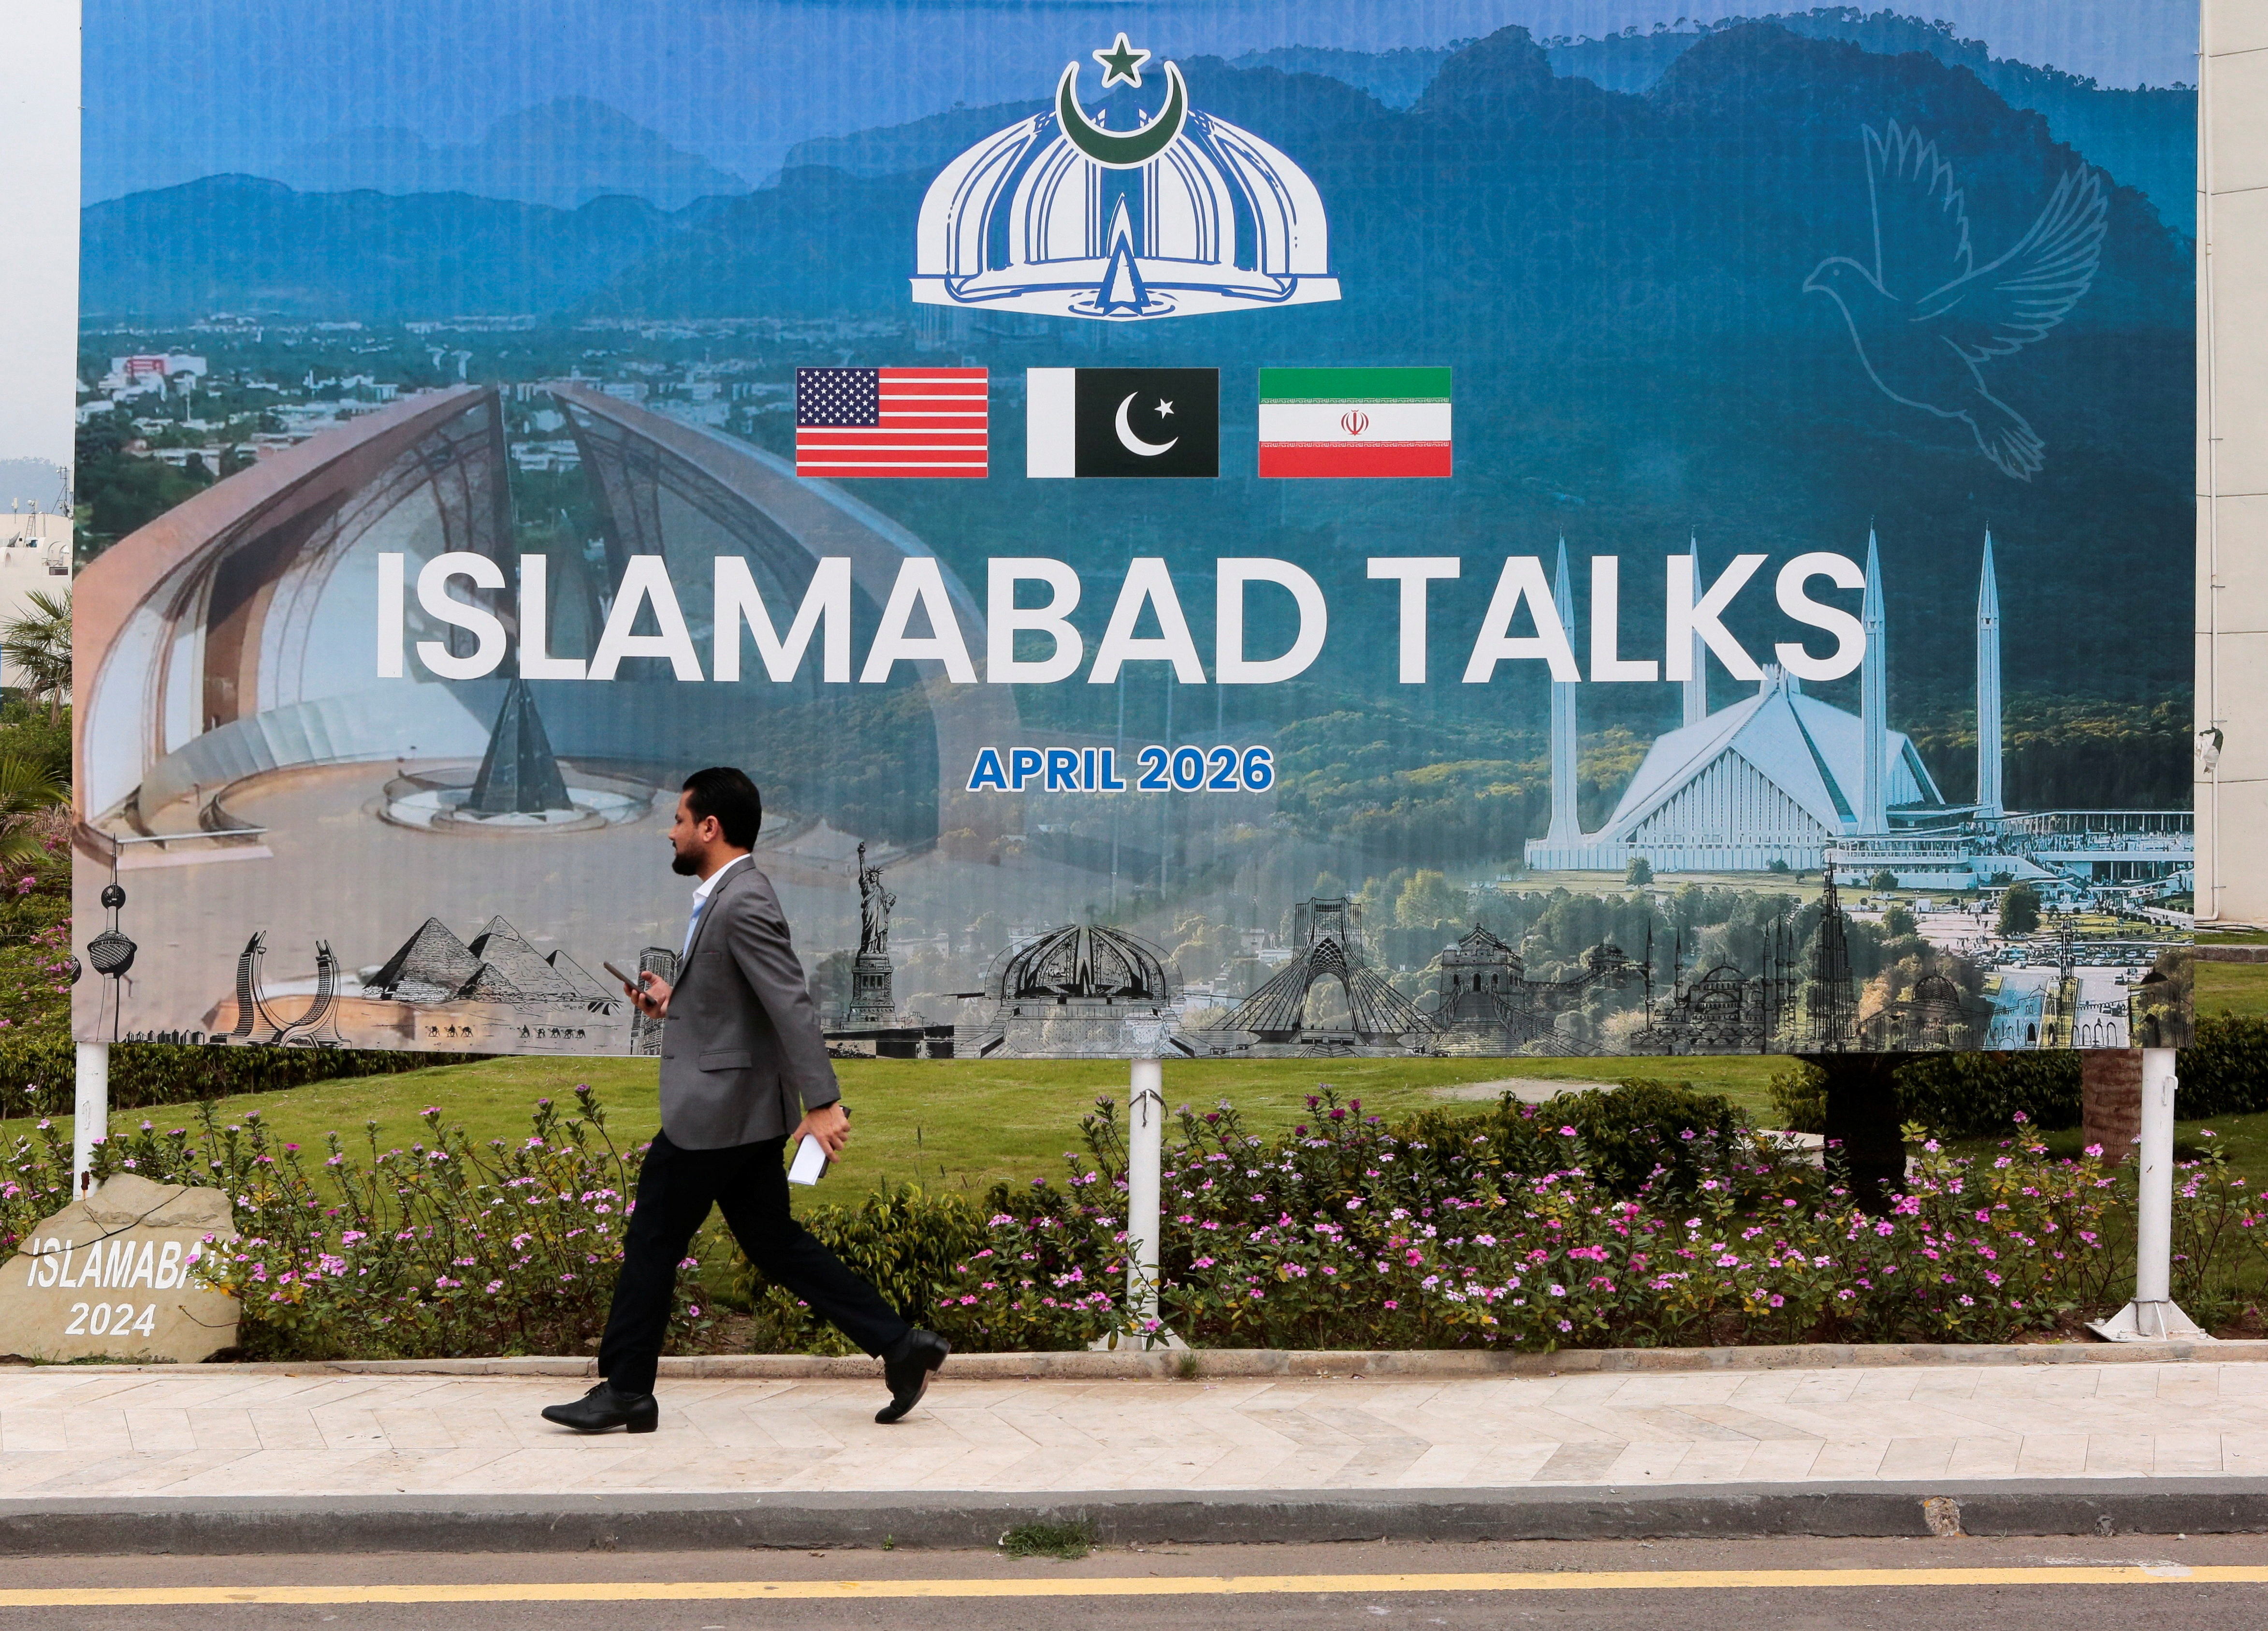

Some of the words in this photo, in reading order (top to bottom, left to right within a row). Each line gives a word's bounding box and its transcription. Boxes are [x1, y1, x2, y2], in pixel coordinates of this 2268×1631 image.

[377, 551, 1327, 684] ISLAMABAD
[1367, 552, 1867, 684] TALKS
[966, 746, 1127, 793] APRIL
[1137, 745, 1275, 793] 2026
[64, 1302, 157, 1337] 2024
